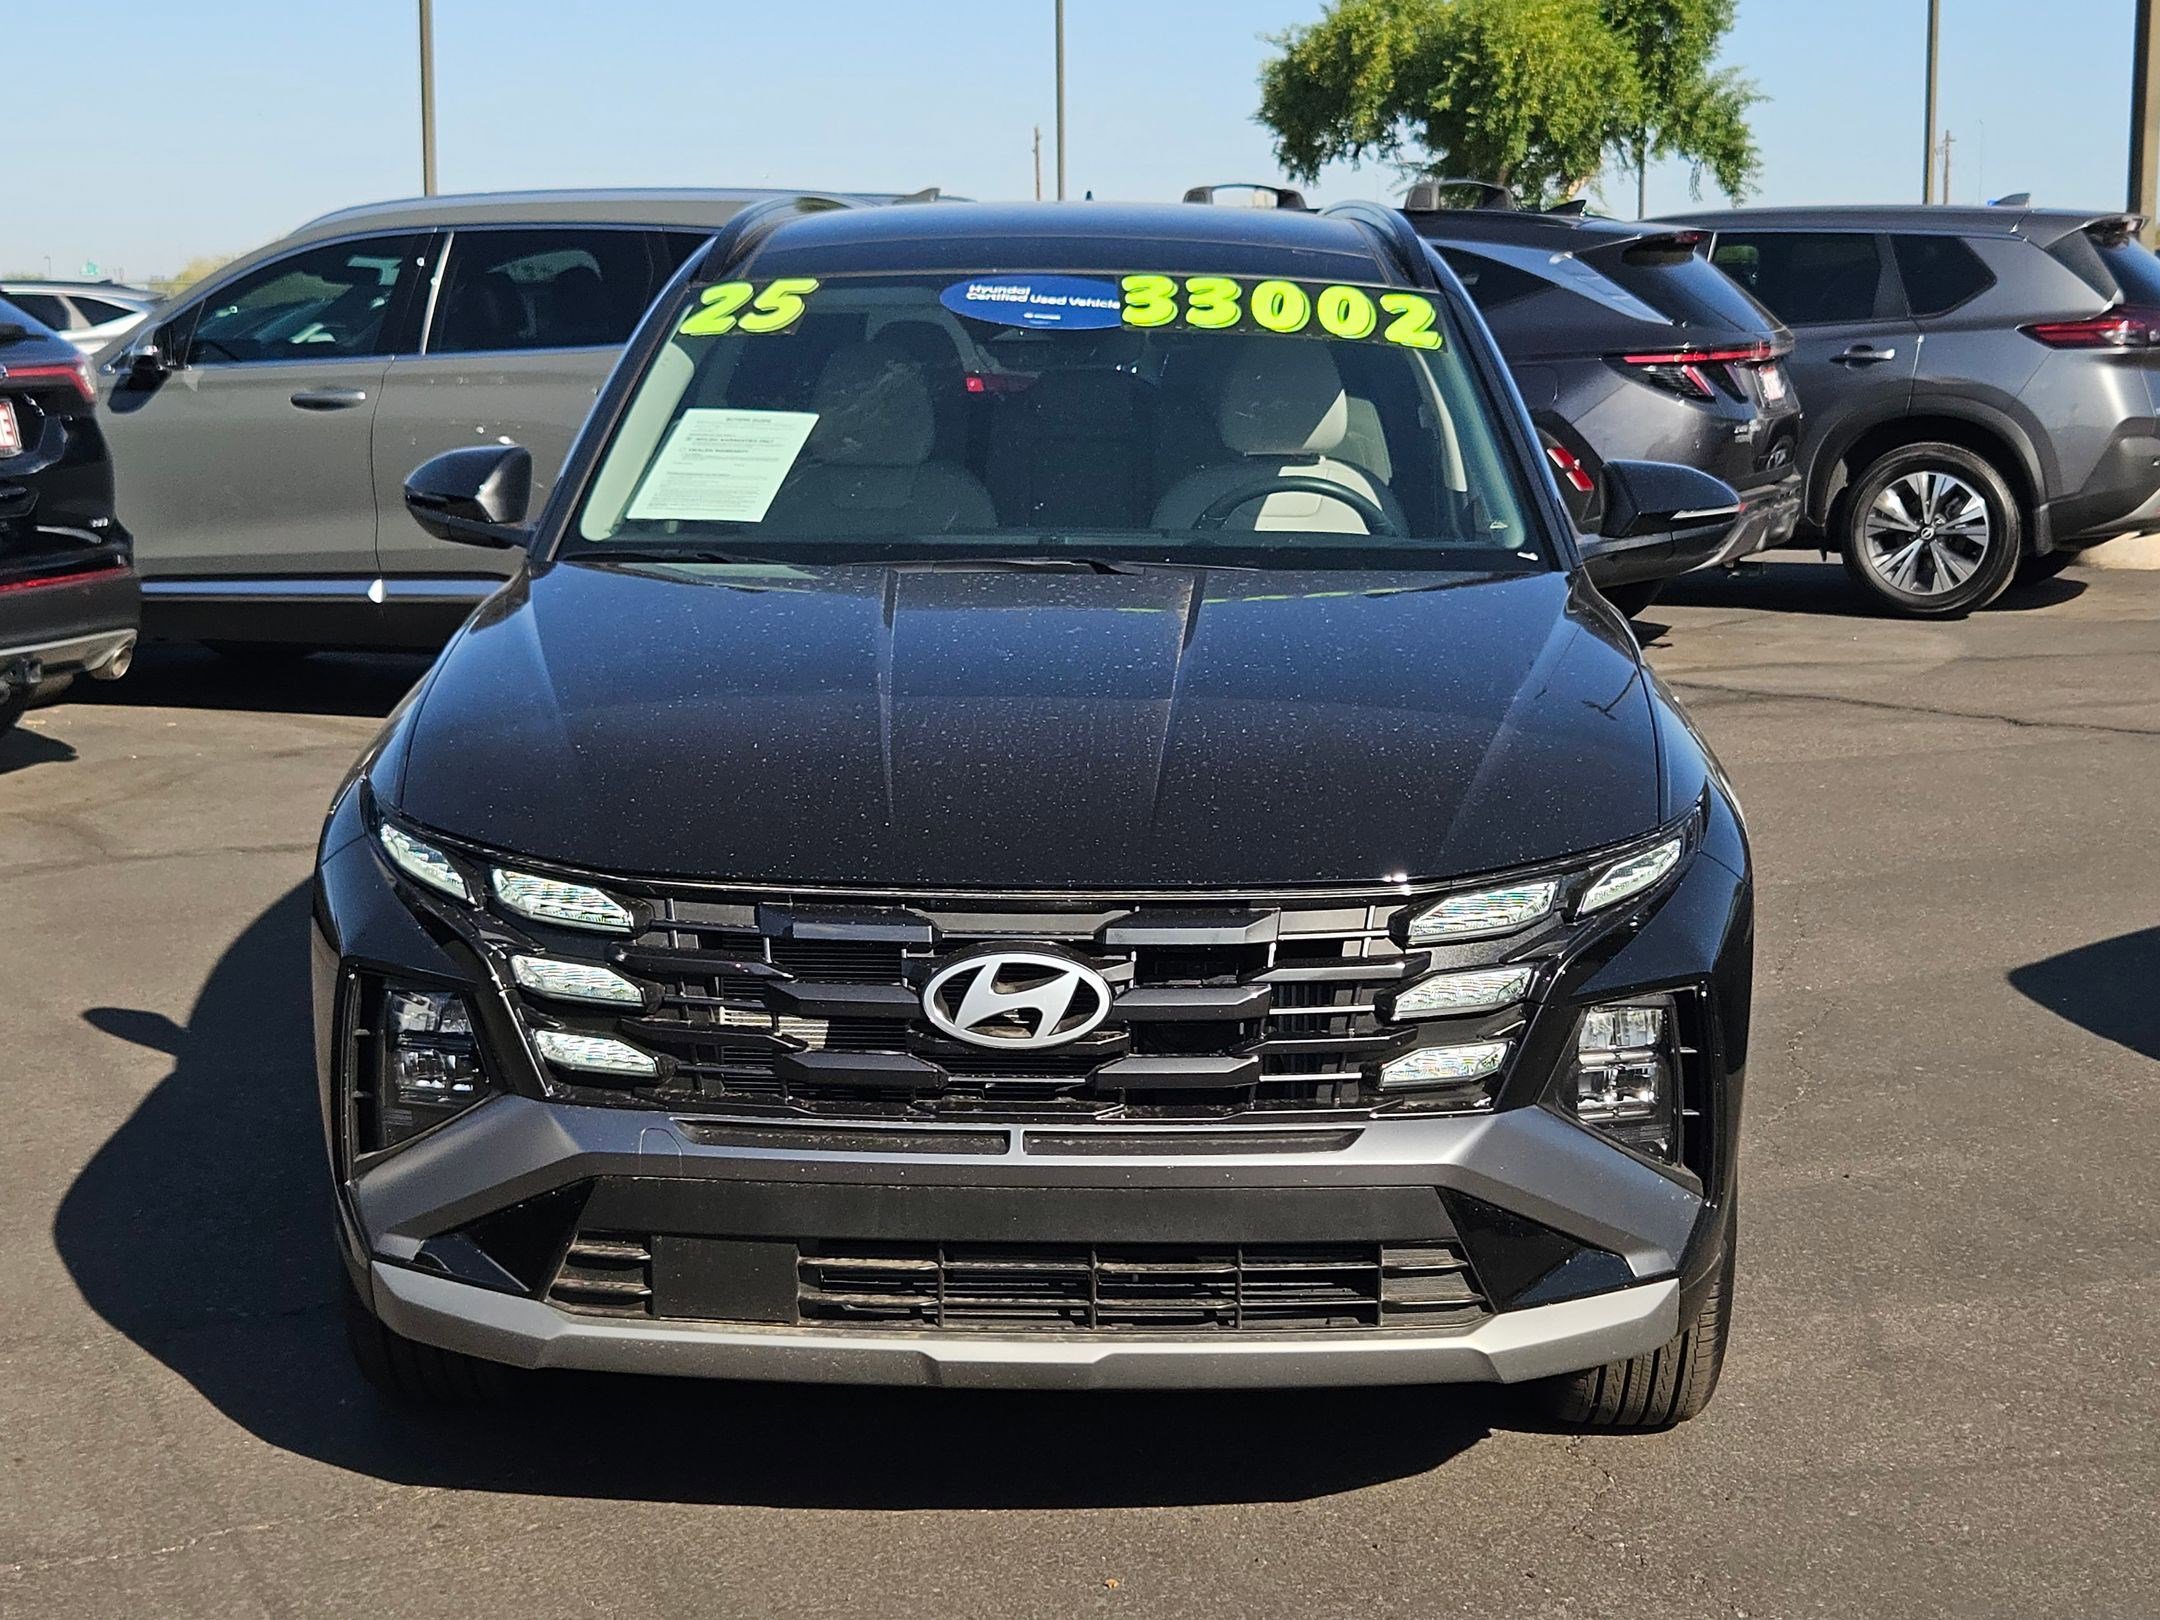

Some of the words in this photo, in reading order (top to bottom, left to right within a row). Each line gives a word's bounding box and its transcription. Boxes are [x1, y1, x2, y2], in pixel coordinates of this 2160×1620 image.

[679, 277, 820, 336] 25
[966, 291, 1030, 304] Certified
[1030, 294, 1067, 306] Used
[968, 283, 1031, 296] Hyundai
[1121, 275, 1443, 350] 33002
